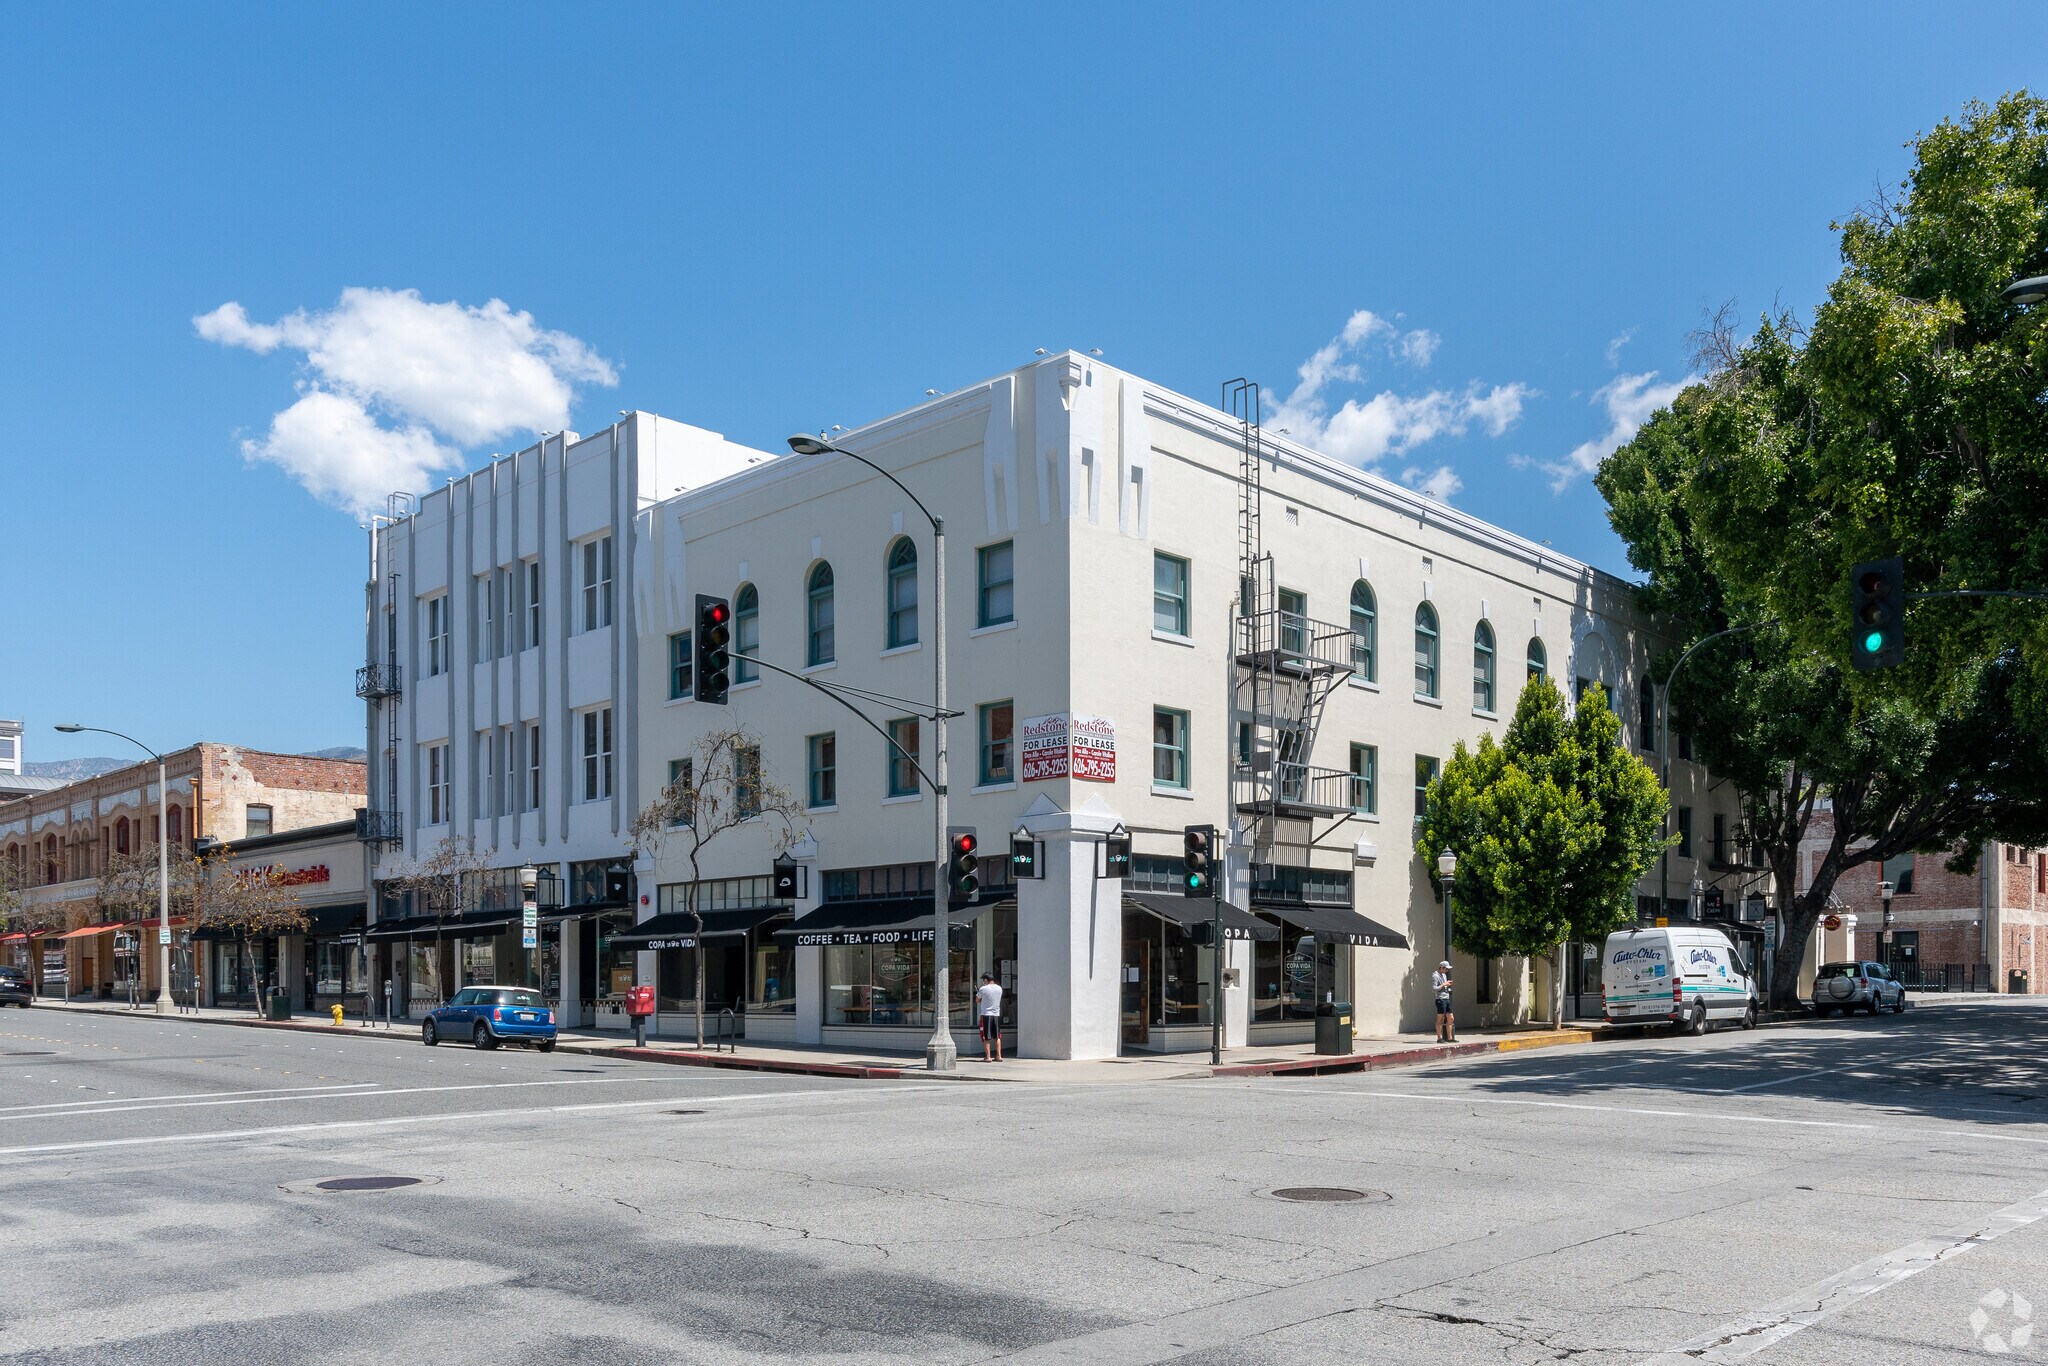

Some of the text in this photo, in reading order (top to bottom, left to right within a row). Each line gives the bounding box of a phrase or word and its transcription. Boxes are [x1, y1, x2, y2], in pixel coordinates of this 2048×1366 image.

[1024, 721, 1067, 736] Redstone
[1074, 719, 1115, 736] Redstone
[1024, 736, 1068, 750] FOR LEASE
[1074, 736, 1115, 750] FOR LEASE
[1024, 757, 1068, 779] 626-795-2255
[1074, 757, 1115, 778] 626-795-2255
[648, 940, 666, 949] COPA
[798, 930, 934, 945] COFFEE TEA FOOD LIFE
[1225, 928, 1379, 946] OPA VIDA
[1613, 947, 1662, 965] Auto-Chlor
[1690, 949, 1717, 965] Auto-Chlor
